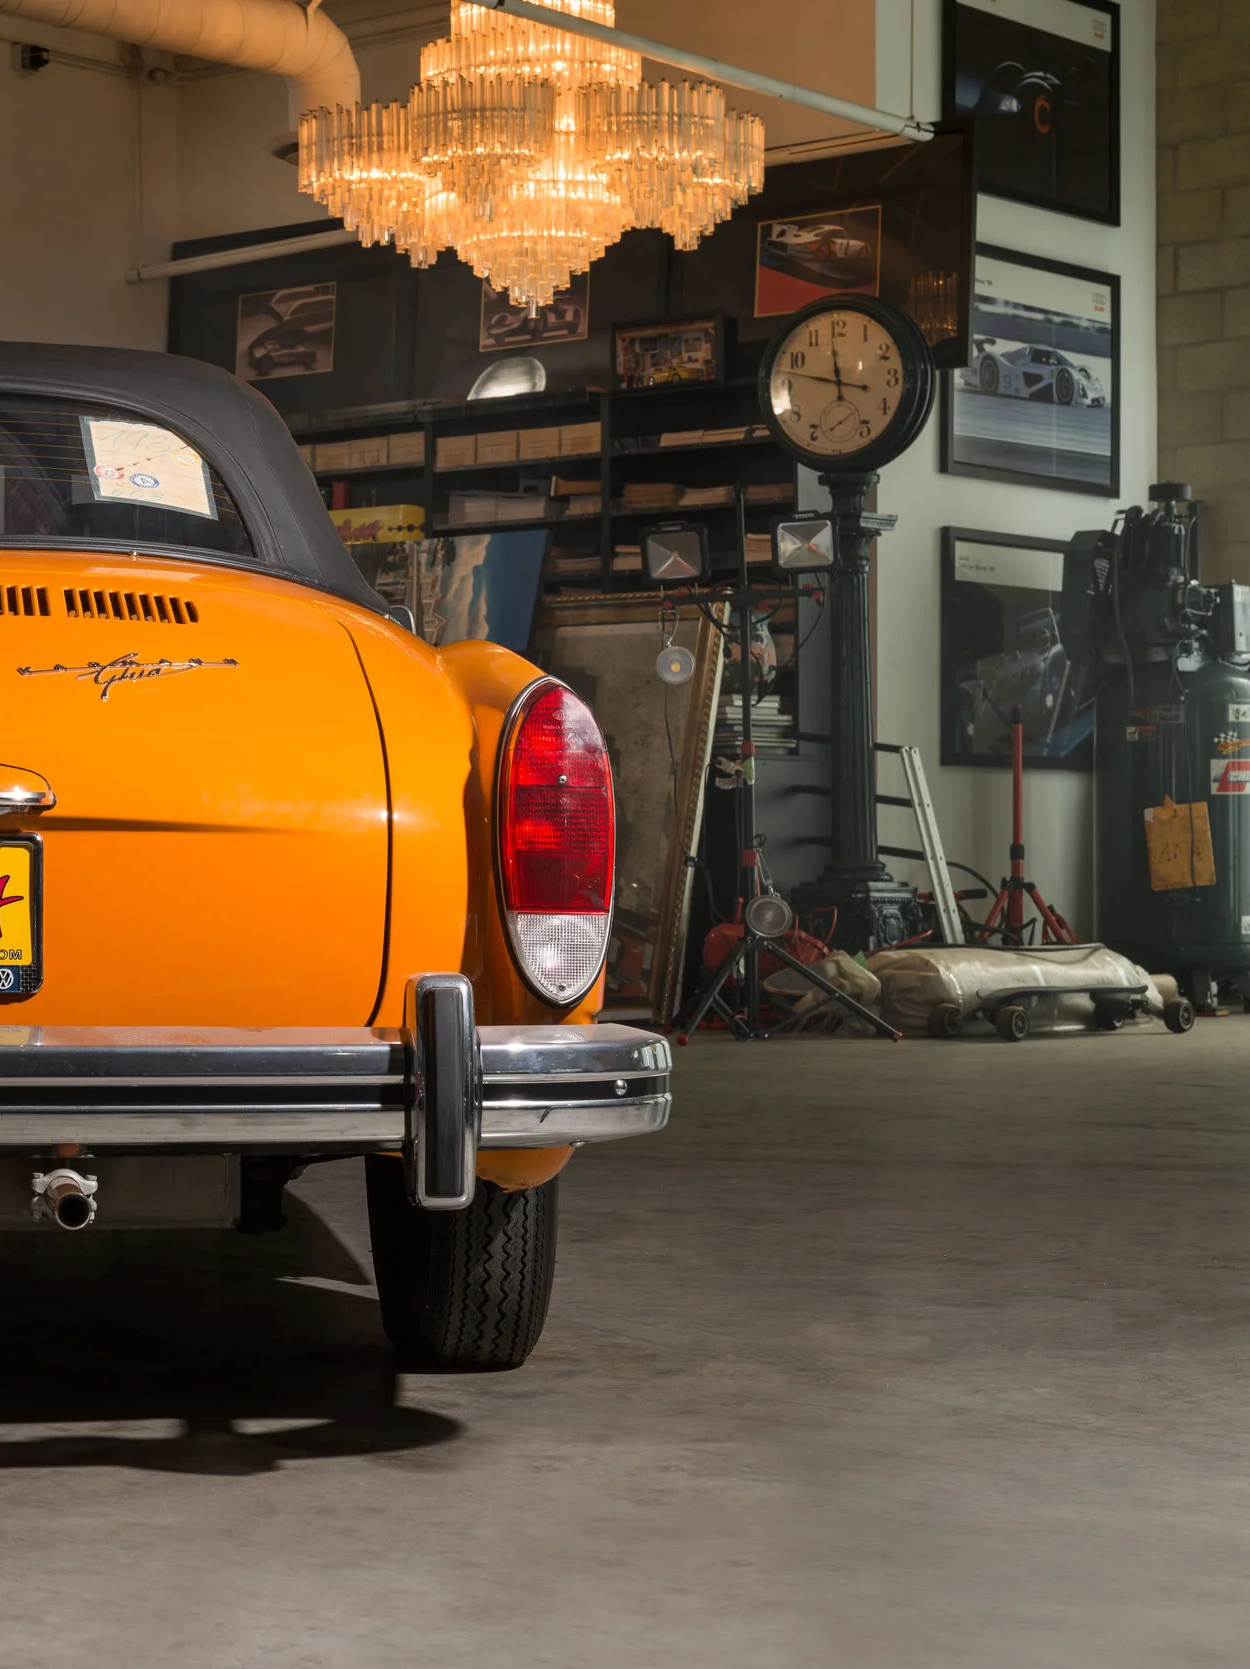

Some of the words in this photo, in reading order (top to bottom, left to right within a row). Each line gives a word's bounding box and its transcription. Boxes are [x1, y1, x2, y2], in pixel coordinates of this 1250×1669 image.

[808, 329, 819, 347] 11
[830, 319, 847, 338] 12
[862, 324, 868, 342] 1
[789, 350, 805, 370] 10
[878, 343, 891, 361] 2
[886, 368, 899, 388] 3
[877, 397, 890, 416] 4
[808, 423, 820, 441] 7
[858, 419, 871, 438] 5
